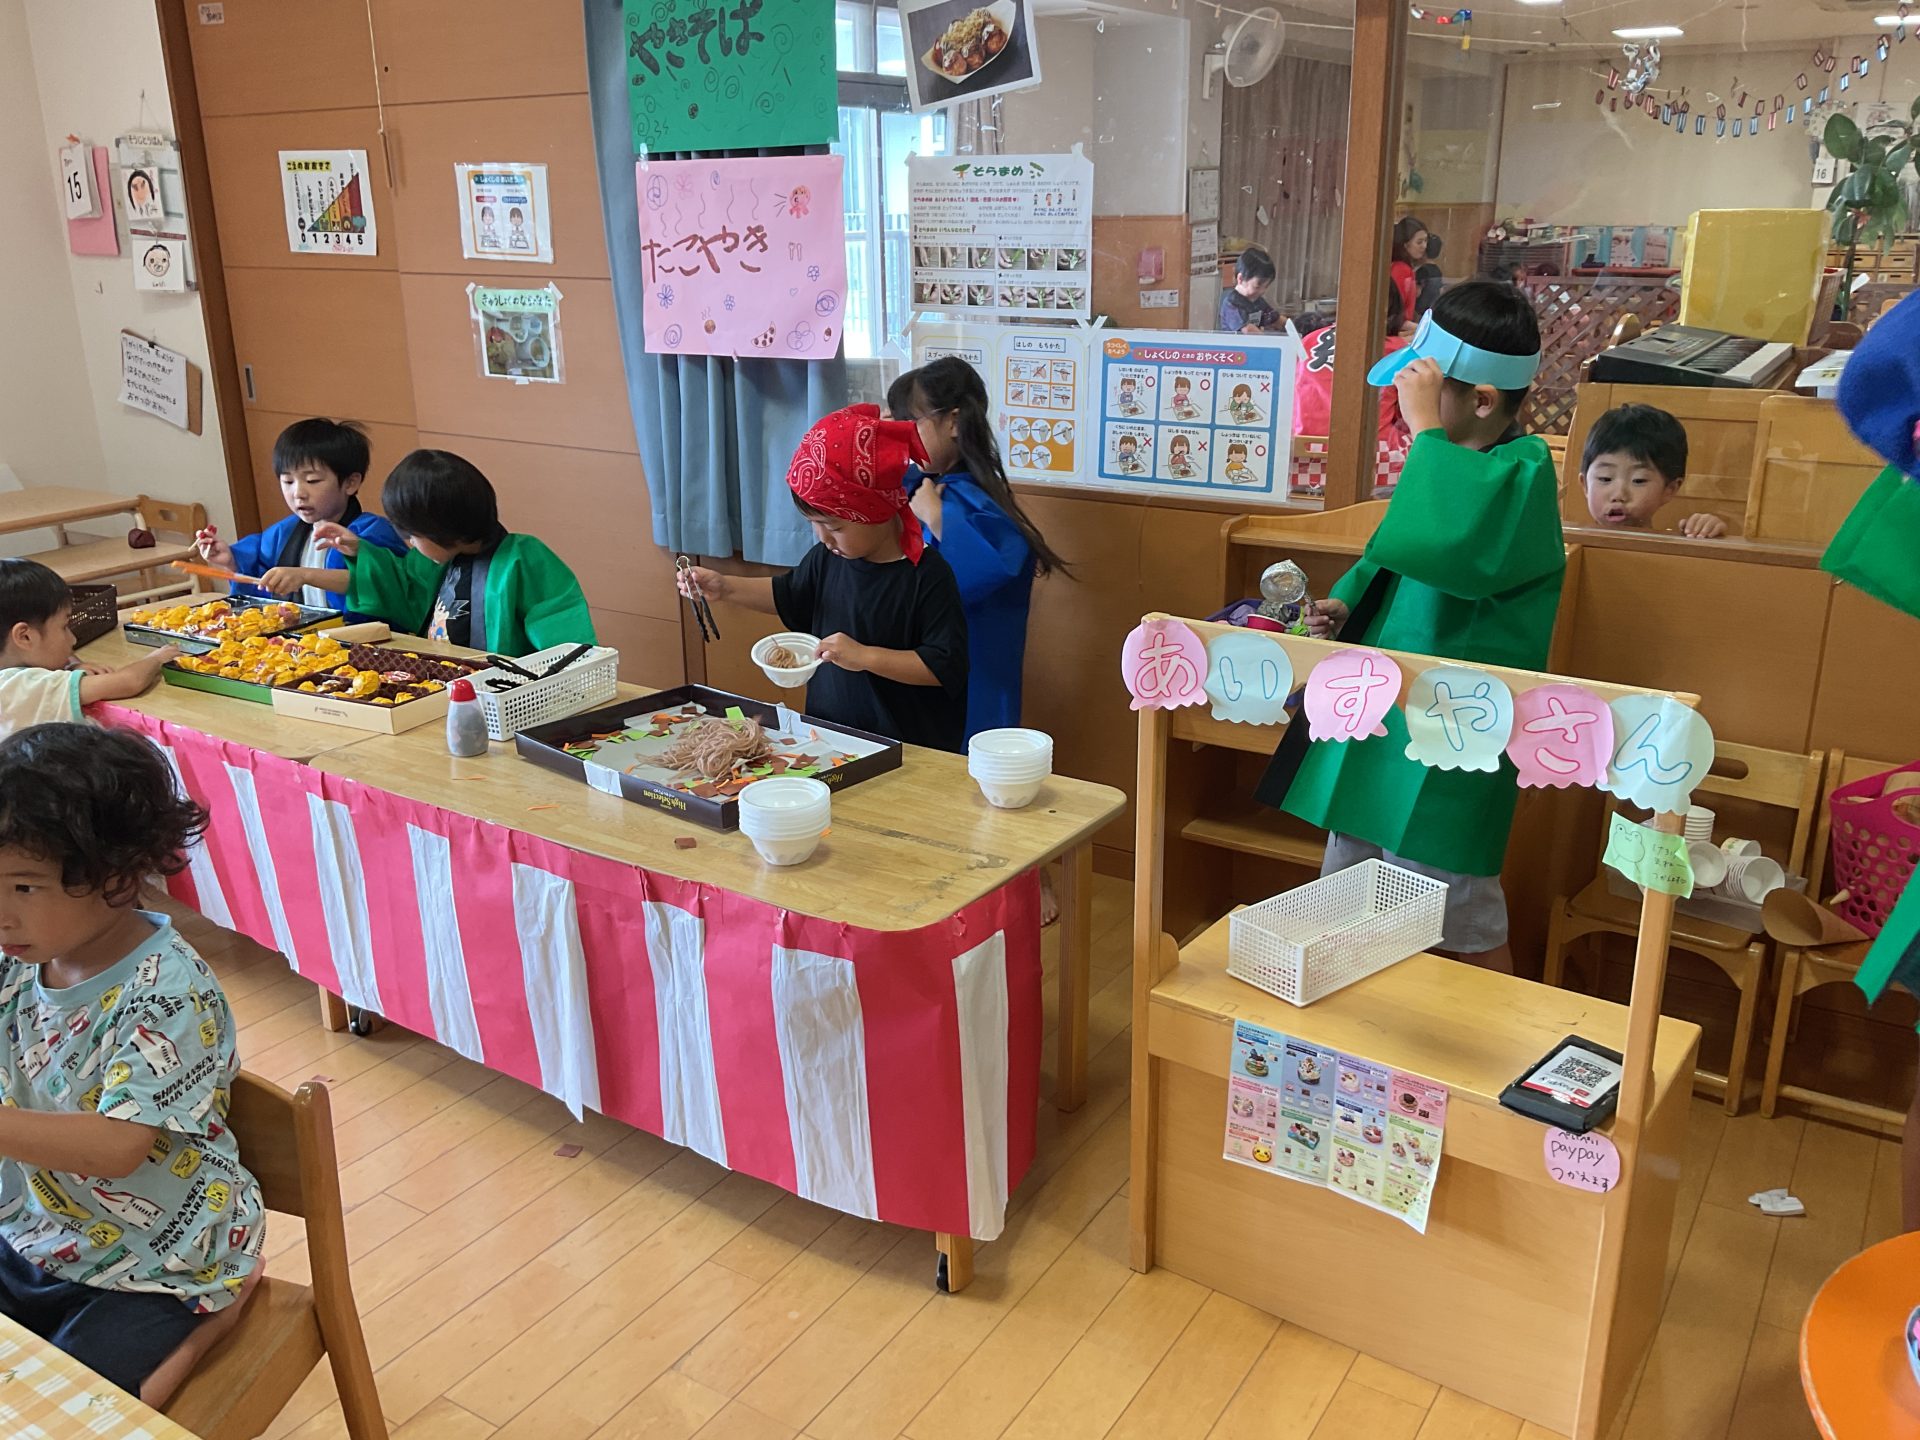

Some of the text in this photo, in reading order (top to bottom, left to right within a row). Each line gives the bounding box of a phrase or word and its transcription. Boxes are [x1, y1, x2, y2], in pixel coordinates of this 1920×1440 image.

[972, 166, 1024, 177] そらまめ
[1816, 168, 1827, 180] 16
[67, 171, 82, 203] 15
[301, 233, 363, 245] 0 1 2 3 4 5
[641, 225, 768, 284] たこやき
[1038, 342, 1061, 350] もちかた
[1144, 350, 1180, 360] しょくじの
[1196, 352, 1234, 363] おやくそく
[1134, 632, 1693, 785] あいすやさん
[642, 788, 670, 809] Selection
[668, 795, 688, 812] High
[60, 1051, 80, 1070] SERIES
[152, 1053, 214, 1103] SHINKANSEN
[154, 1064, 217, 1113] TRAIN GARAGE
[1552, 1167, 1610, 1193] つかえます
[148, 1176, 205, 1250] SHINKANSEN
[154, 1223, 183, 1257] TRAIN
[223, 1261, 240, 1272] CLASS
